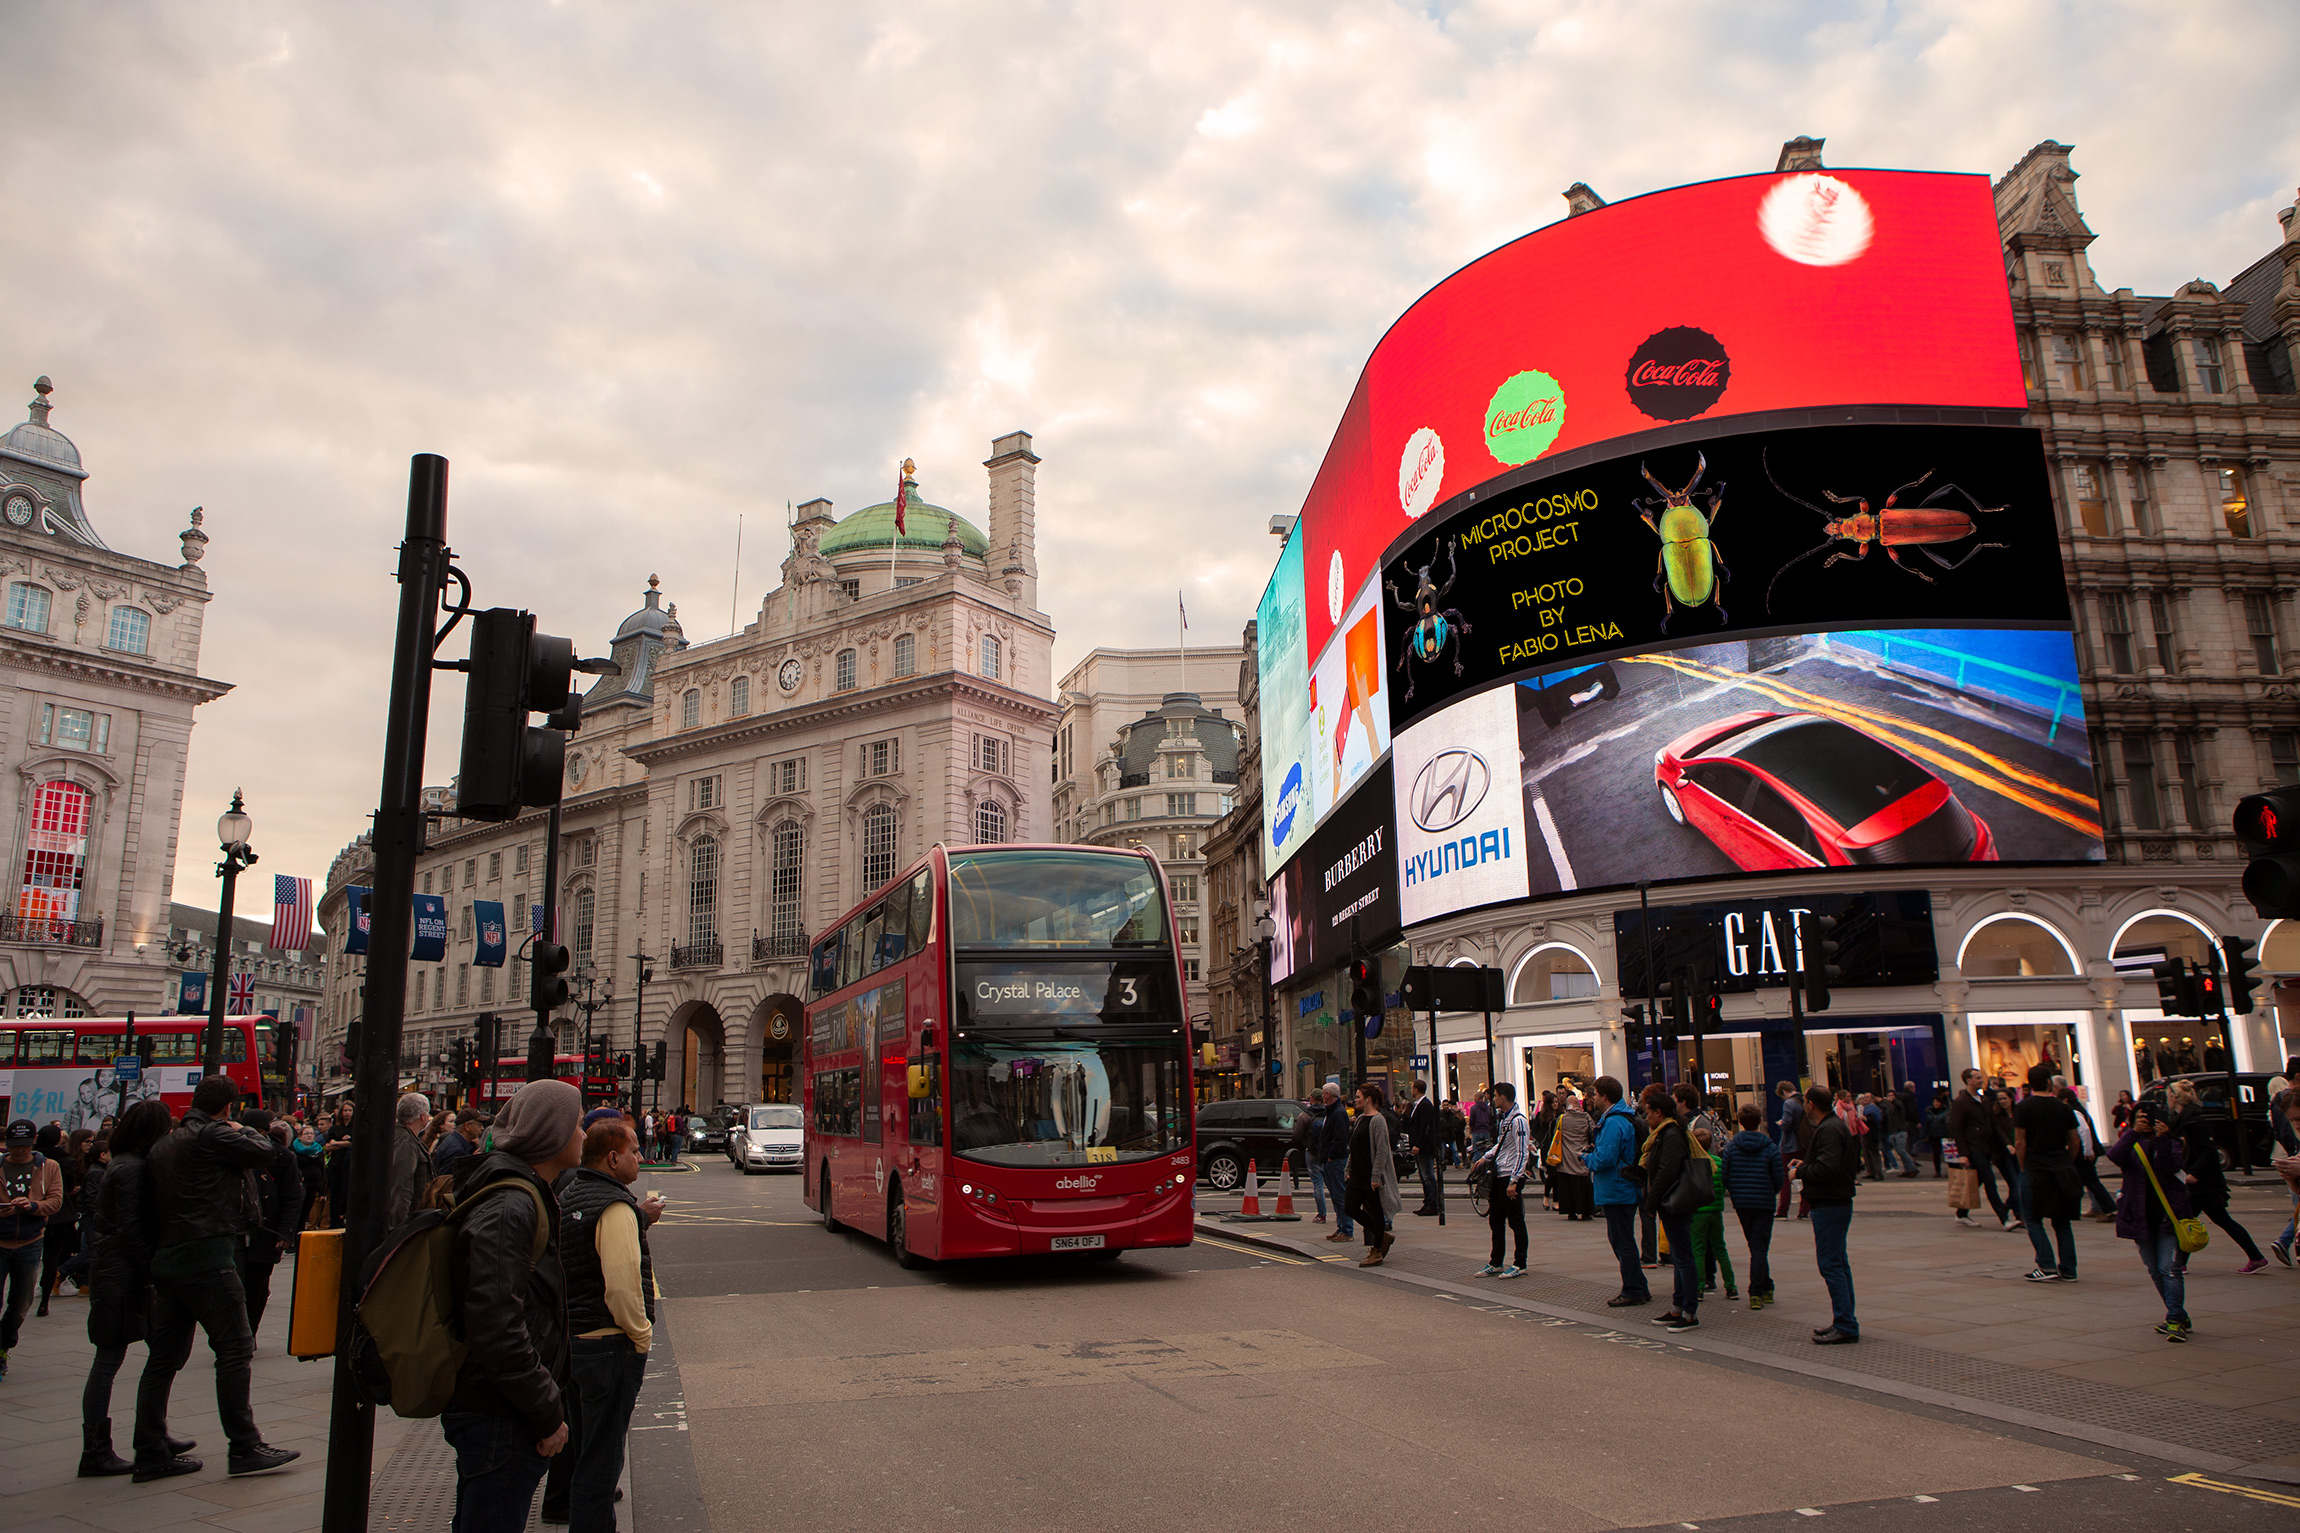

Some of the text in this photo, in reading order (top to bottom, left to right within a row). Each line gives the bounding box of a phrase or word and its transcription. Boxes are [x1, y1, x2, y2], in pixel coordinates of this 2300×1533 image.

[1631, 358, 1727, 387] Coca-Cola
[1489, 395, 1560, 438] Coca-Cola
[1403, 435, 1439, 508] Coca-Cola
[1460, 488, 1599, 550] MICROCOSMO
[1489, 521, 1579, 565] PROJECT
[1511, 577, 1584, 610] PHOTO
[1539, 605, 1565, 628] BY
[1498, 621, 1624, 666] FABIO LENA
[956, 707, 1026, 735] ALLIANCE LIFE OFFICE
[1275, 781, 1299, 829] SAMSUNG
[1324, 825, 1384, 893] BURBERRY
[1405, 827, 1511, 888] HYUNDAI
[1338, 901, 1358, 923] REGENT
[1357, 886, 1380, 911] STREET
[418, 924, 446, 932] REGENT
[418, 931, 446, 939] STREET
[419, 917, 434, 925] NFL
[486, 931, 500, 943] NFL
[977, 981, 1081, 1003] Crystal Palace
[1119, 978, 1138, 1006] 3
[1092, 1153, 1113, 1163] 318
[1171, 1156, 1190, 1166] 2483
[1056, 1175, 1097, 1189] abellio
[1055, 1236, 1101, 1248] SN64 OFJ
